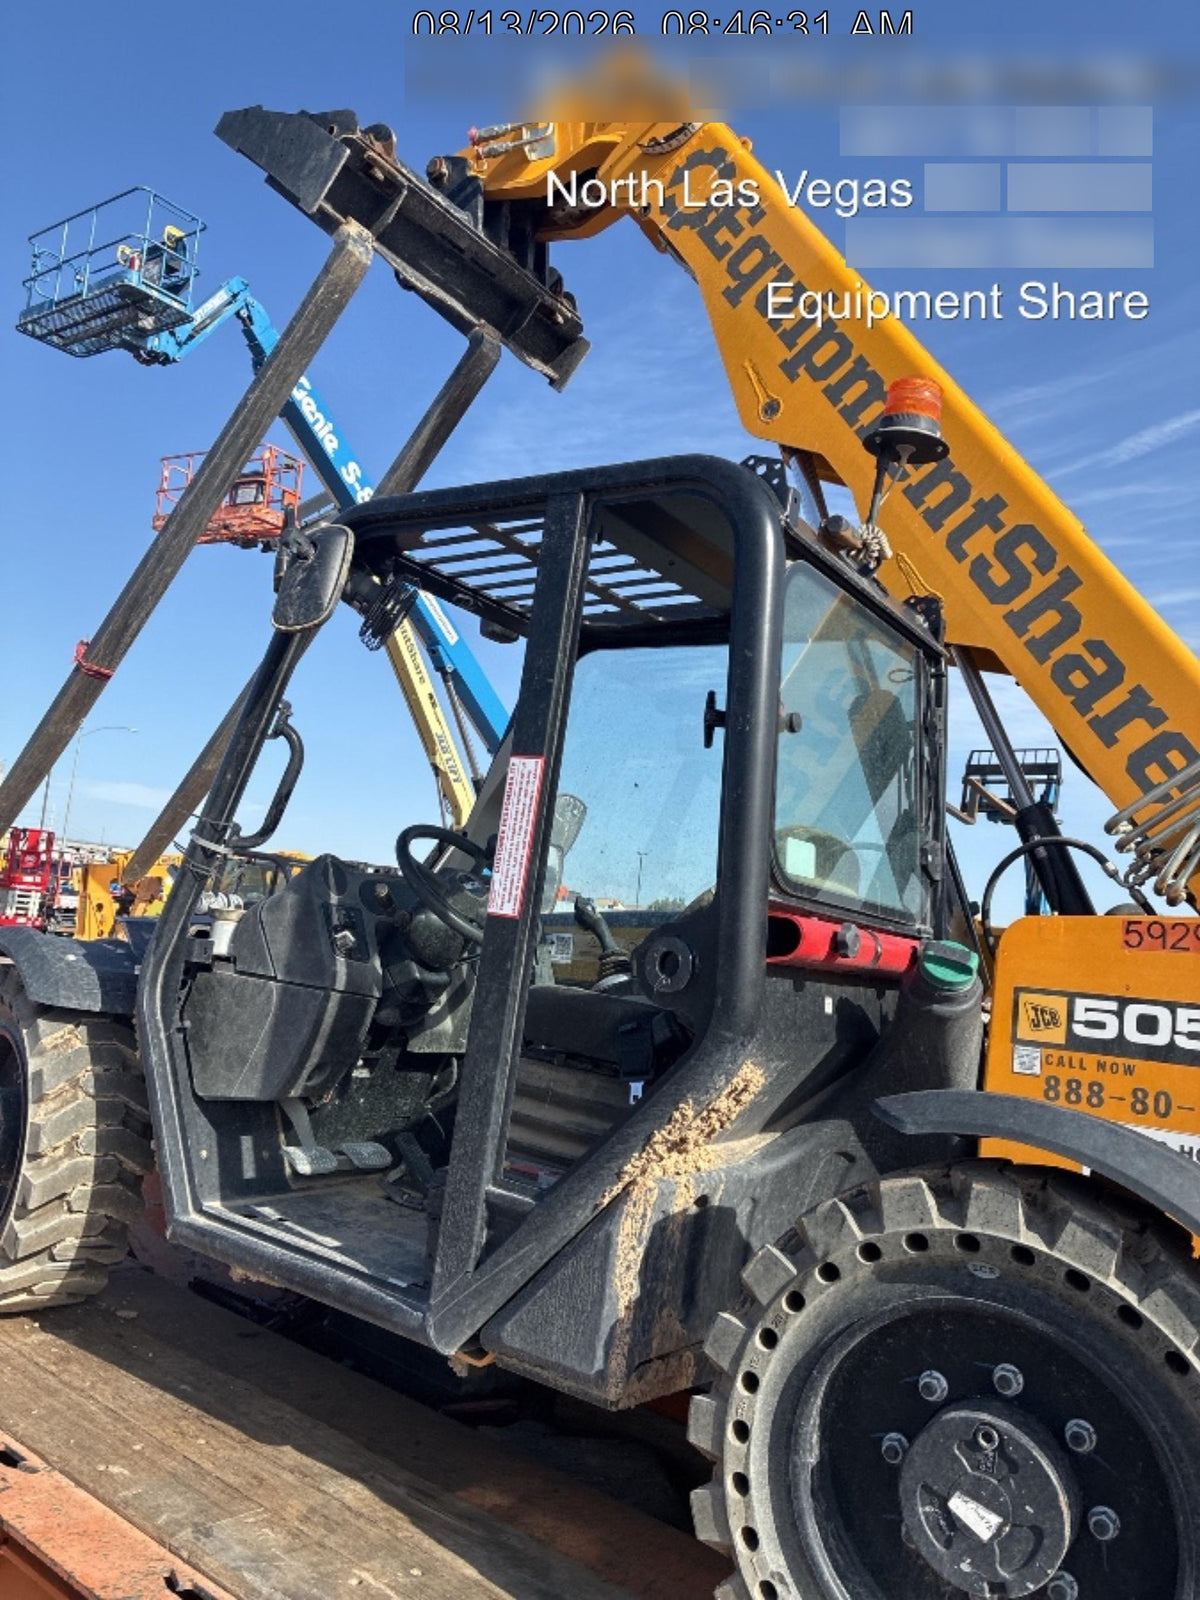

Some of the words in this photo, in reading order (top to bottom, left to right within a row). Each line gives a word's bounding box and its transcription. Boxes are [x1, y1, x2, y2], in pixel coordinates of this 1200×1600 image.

[695, 190, 1200, 805] EquipmntShare
[1030, 1003, 1061, 1030] JCB
[1045, 1053, 1088, 1071] CALL
[1096, 1057, 1137, 1077] NOW
